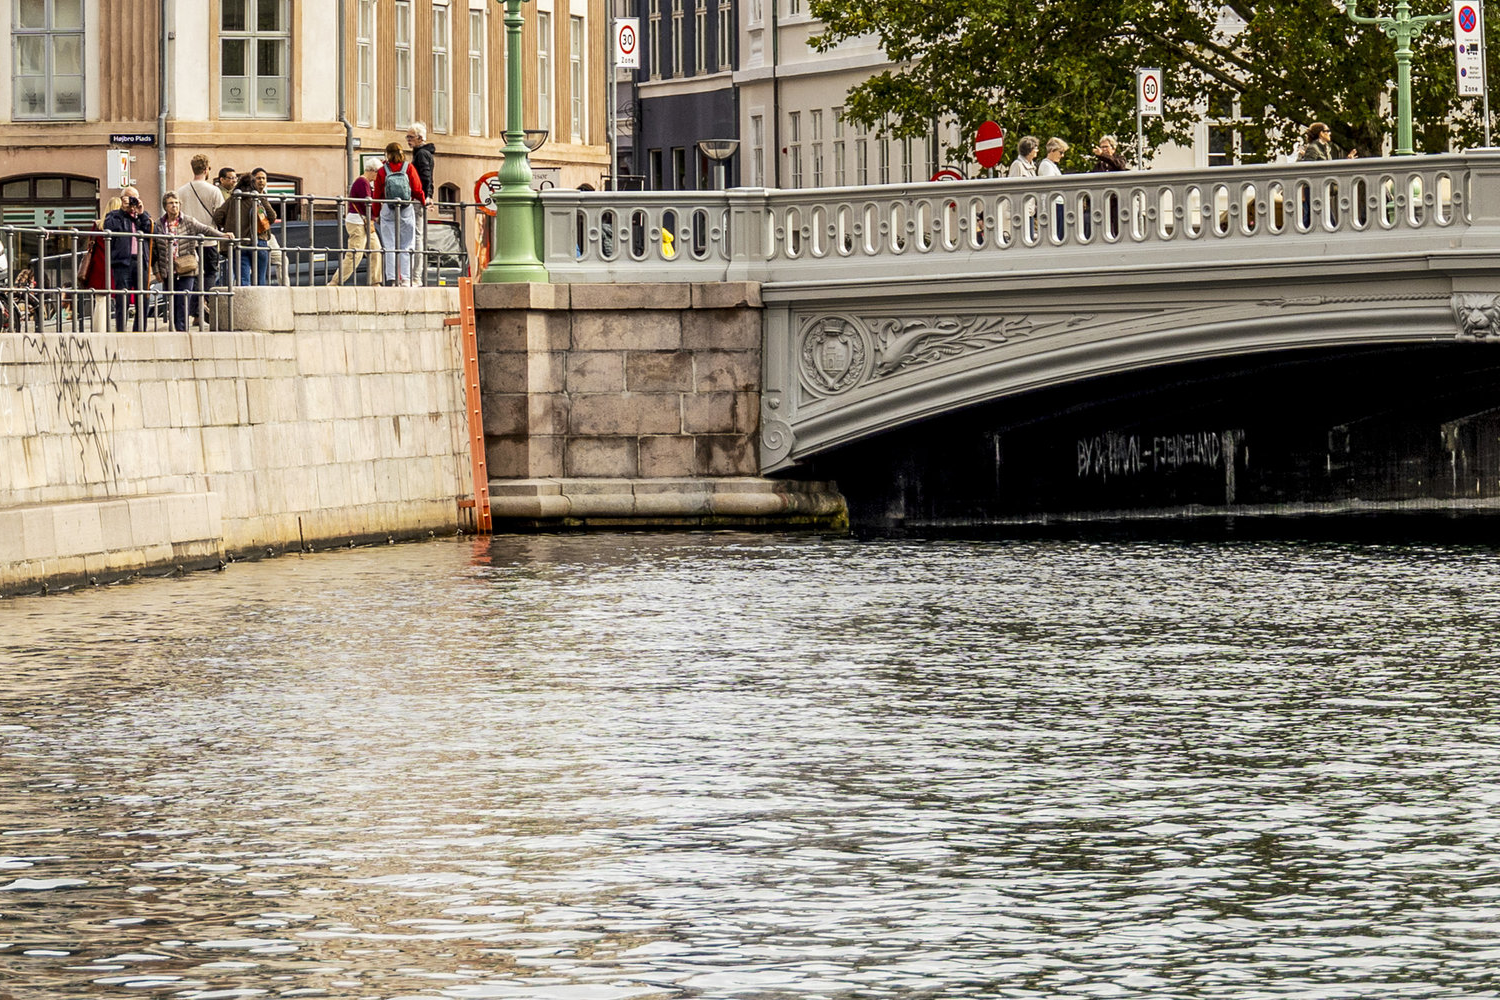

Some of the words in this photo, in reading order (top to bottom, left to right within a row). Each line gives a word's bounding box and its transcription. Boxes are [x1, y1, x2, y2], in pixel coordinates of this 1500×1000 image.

[623, 34, 632, 45] 30
[1146, 83, 1156, 94] 30
[113, 135, 135, 143] Højbro
